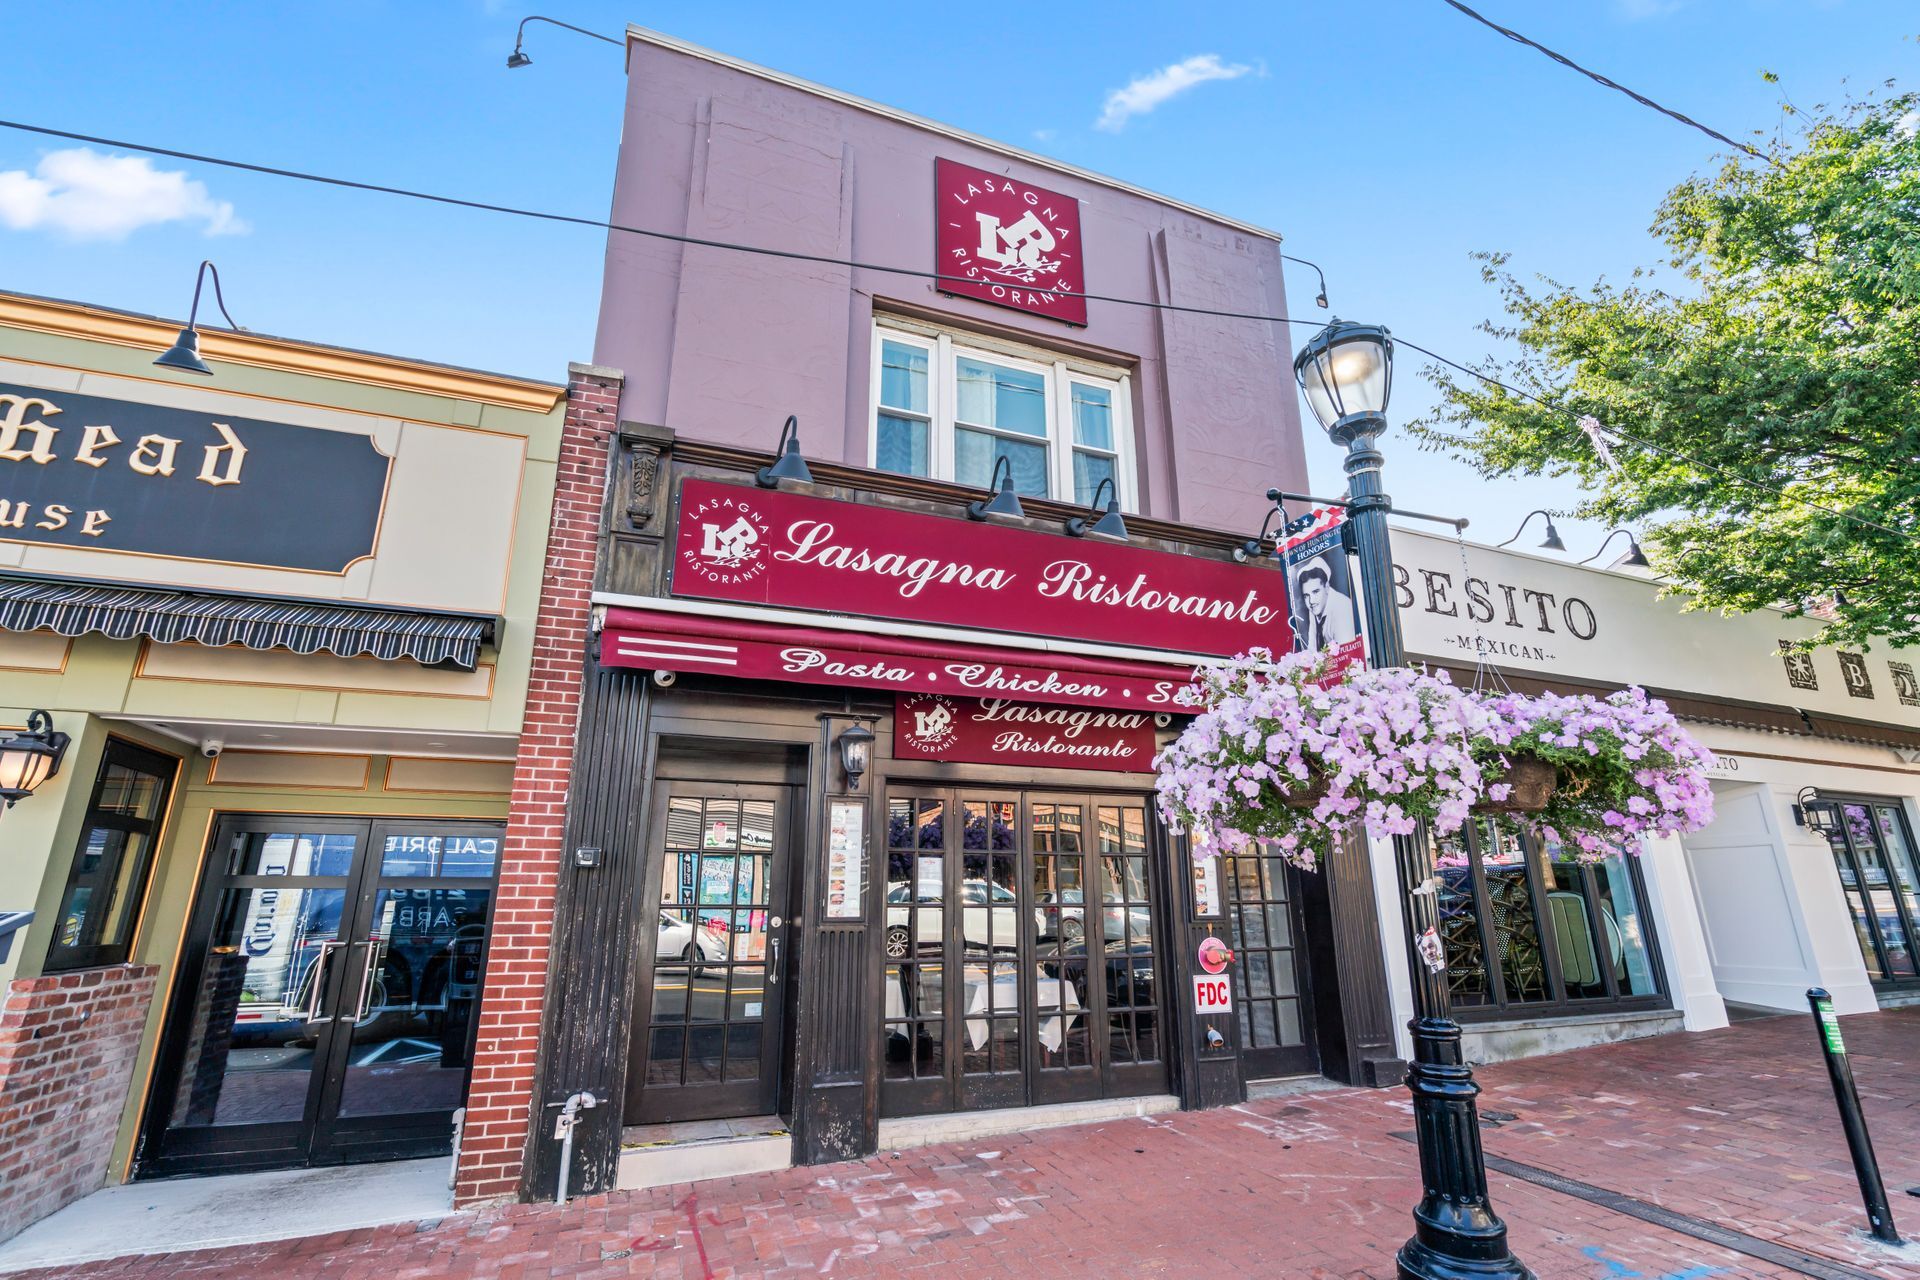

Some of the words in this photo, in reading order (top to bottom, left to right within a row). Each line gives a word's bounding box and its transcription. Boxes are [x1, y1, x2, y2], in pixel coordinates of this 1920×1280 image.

[954, 179, 1069, 240] LASAGNA
[952, 248, 1072, 305] RISTORANTE
[689, 498, 769, 534] LASAGNA
[683, 550, 766, 584] RISTORANTE
[1296, 540, 1330, 560] HONORS
[773, 520, 1017, 598] Lasagna
[1037, 560, 1279, 625] Ristorante
[1456, 634, 1544, 661] MEXICAN
[779, 647, 915, 682] Pasta
[944, 664, 1108, 698] Chicken
[903, 693, 958, 714] LASAGNA
[971, 697, 1150, 739] Lasagna
[903, 733, 958, 753] RISTORANTE
[991, 731, 1137, 758] Ristorante
[1196, 981, 1228, 1006] FDC
